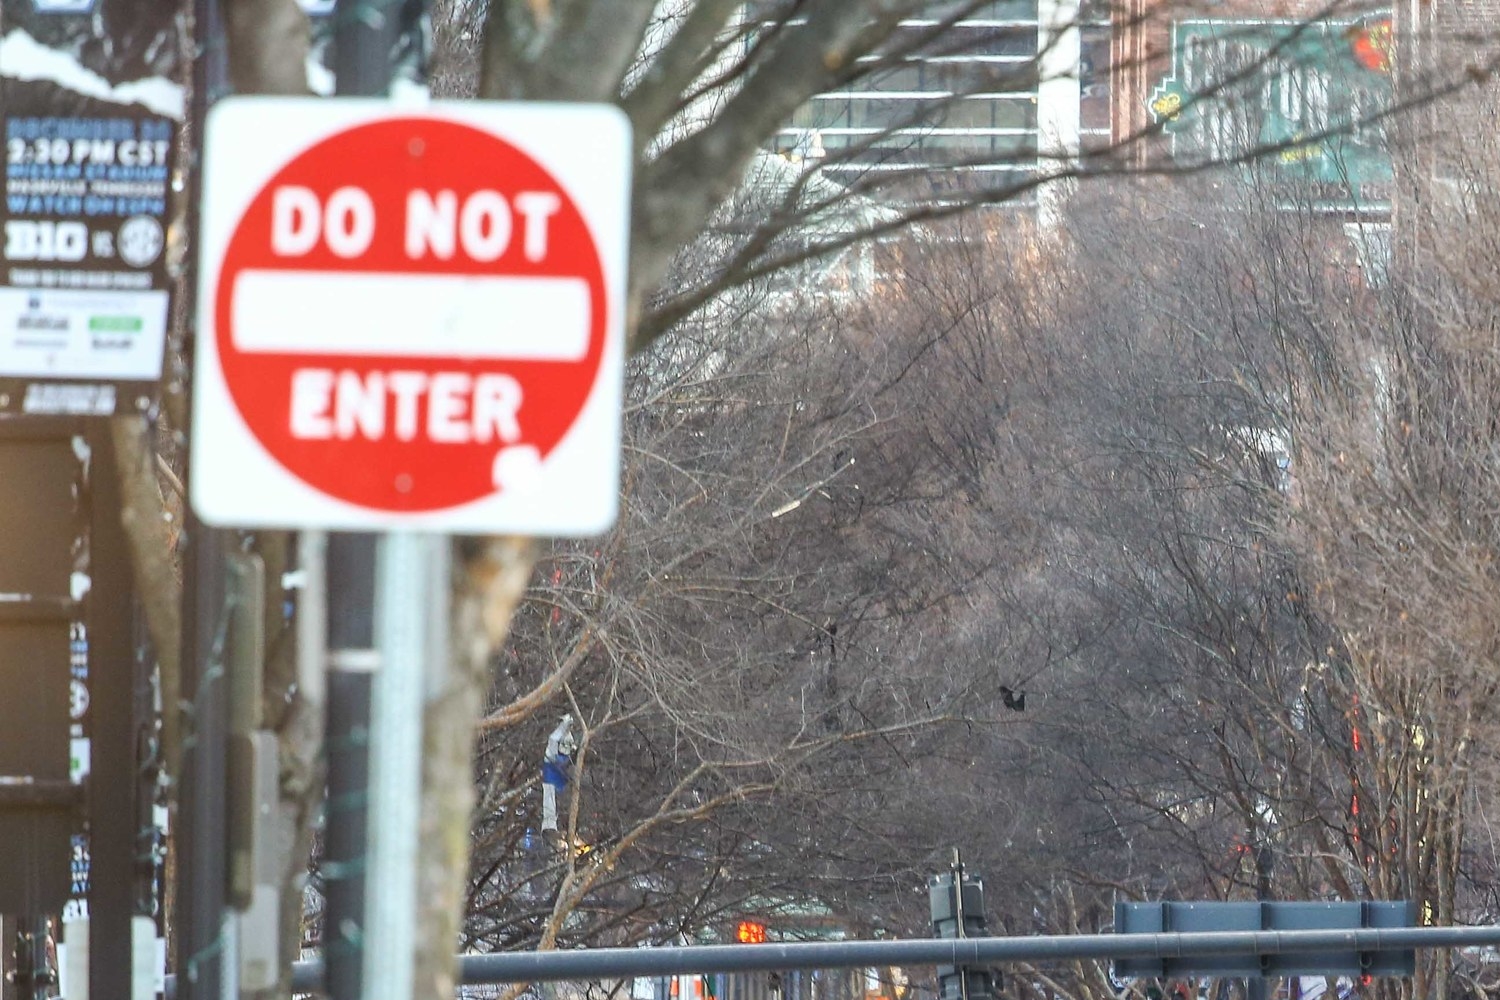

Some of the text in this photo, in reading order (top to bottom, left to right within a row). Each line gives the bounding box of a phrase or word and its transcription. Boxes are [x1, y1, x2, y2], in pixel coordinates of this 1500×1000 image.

[7, 137, 170, 167] 2:30 PM CST
[271, 185, 562, 262] DO NOT
[289, 368, 524, 445] ENTER
